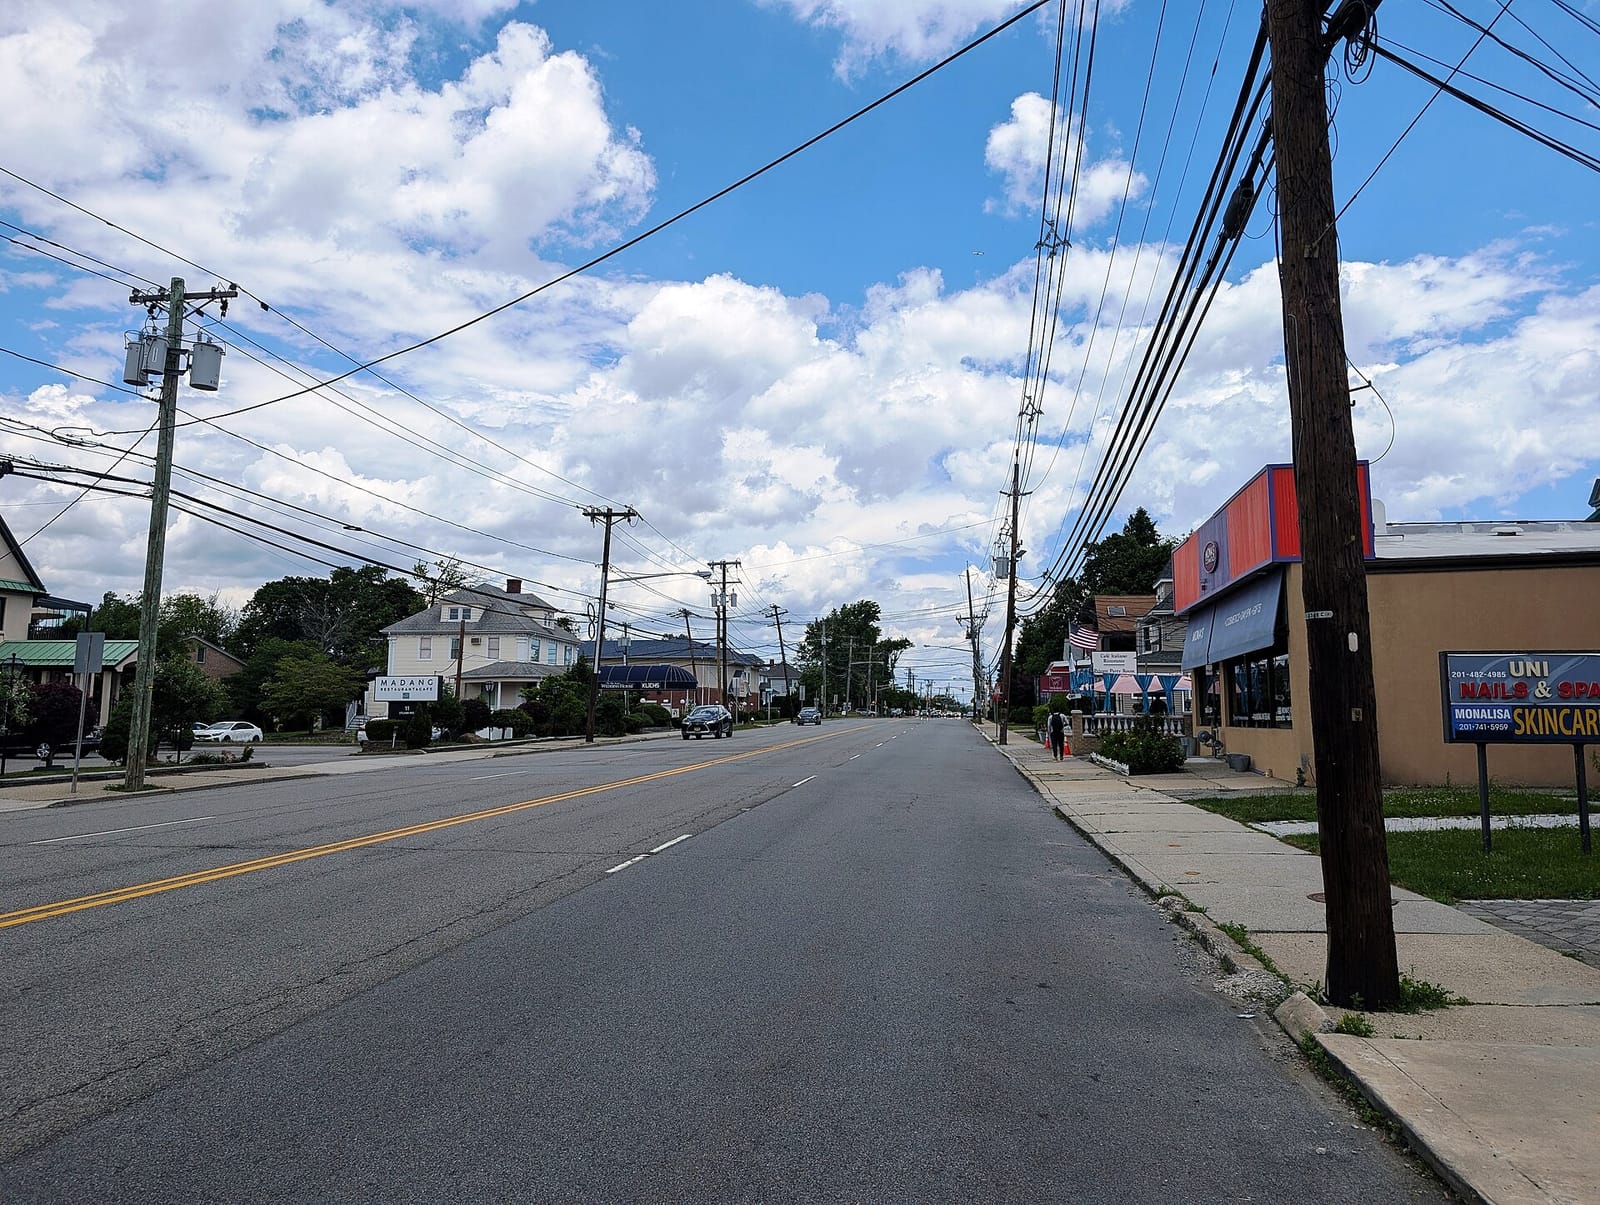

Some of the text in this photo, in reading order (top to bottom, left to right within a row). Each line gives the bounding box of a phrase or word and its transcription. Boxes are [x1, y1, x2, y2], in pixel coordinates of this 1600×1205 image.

[1509, 661, 1549, 677] UNI
[1460, 680, 1600, 699] NAILS & SPA
[1455, 708, 1511, 719] MONALISA
[1513, 708, 1600, 736] SKINCAR
